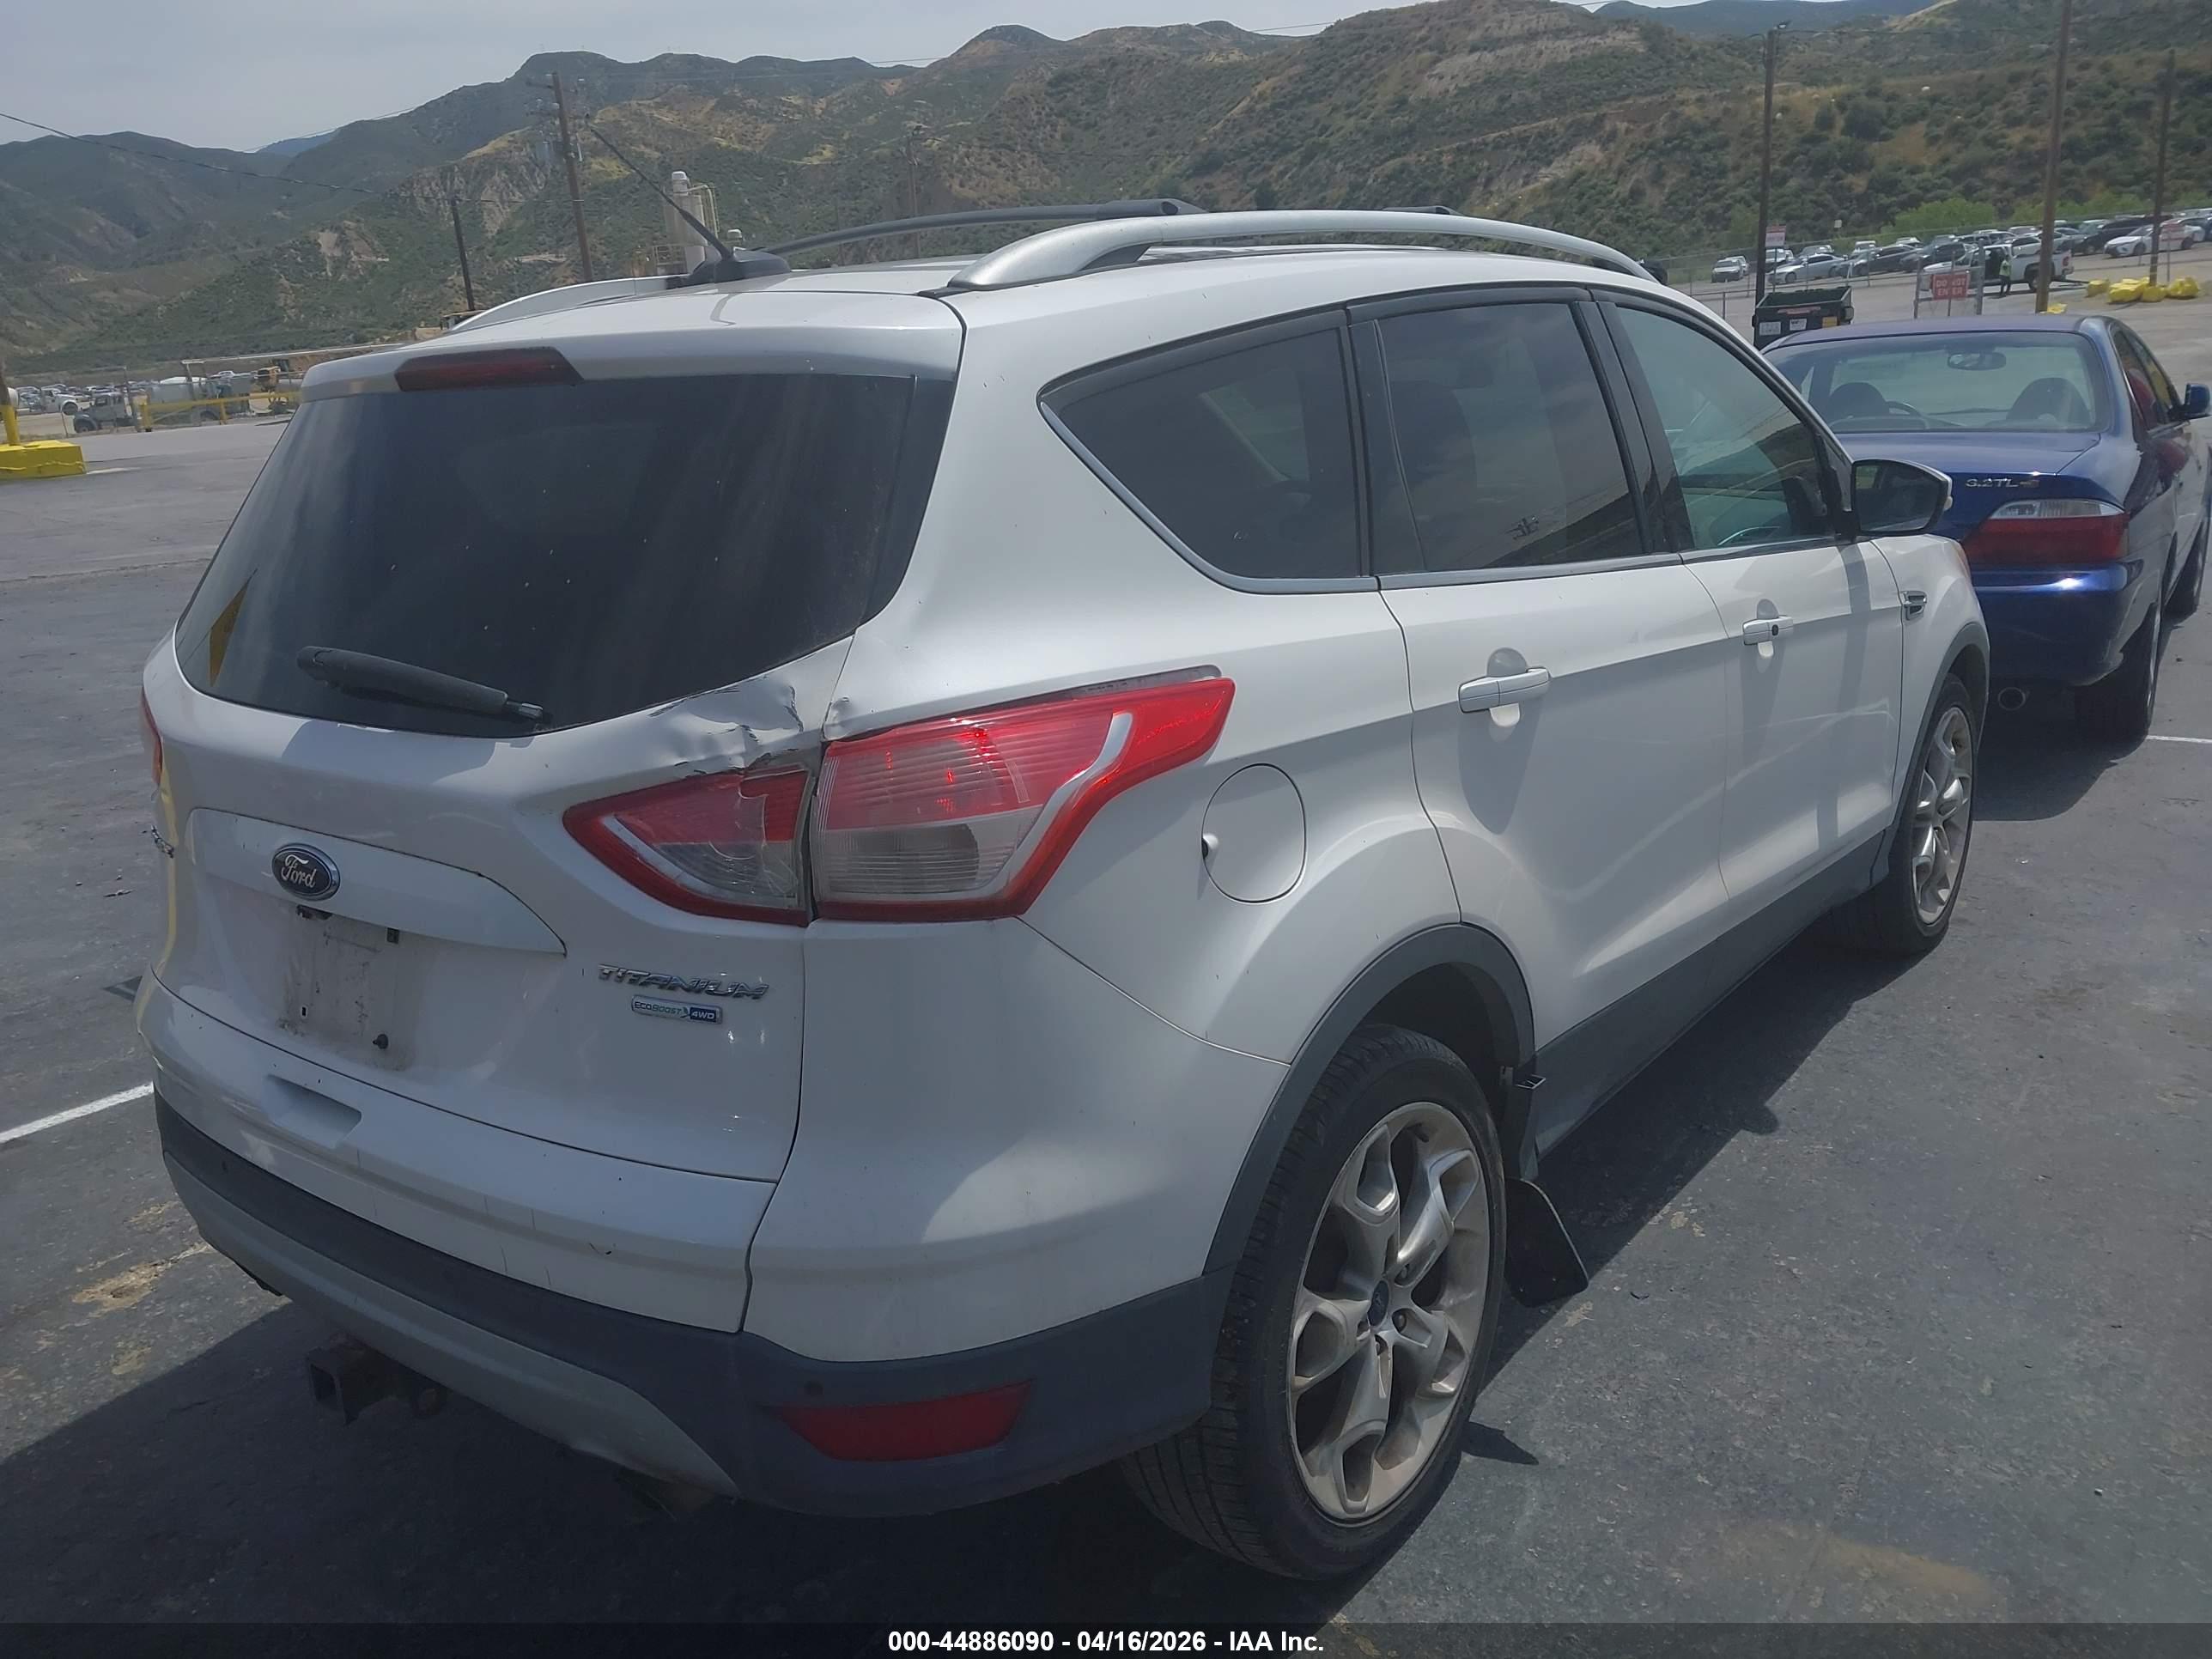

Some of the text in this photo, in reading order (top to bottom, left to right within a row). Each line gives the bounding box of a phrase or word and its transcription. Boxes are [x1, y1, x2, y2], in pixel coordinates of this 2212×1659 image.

[1937, 287, 1963, 296] ENER
[281, 854, 317, 888] Ford
[599, 964, 769, 1000] TITANIUM
[691, 1010, 714, 1020] 4WD
